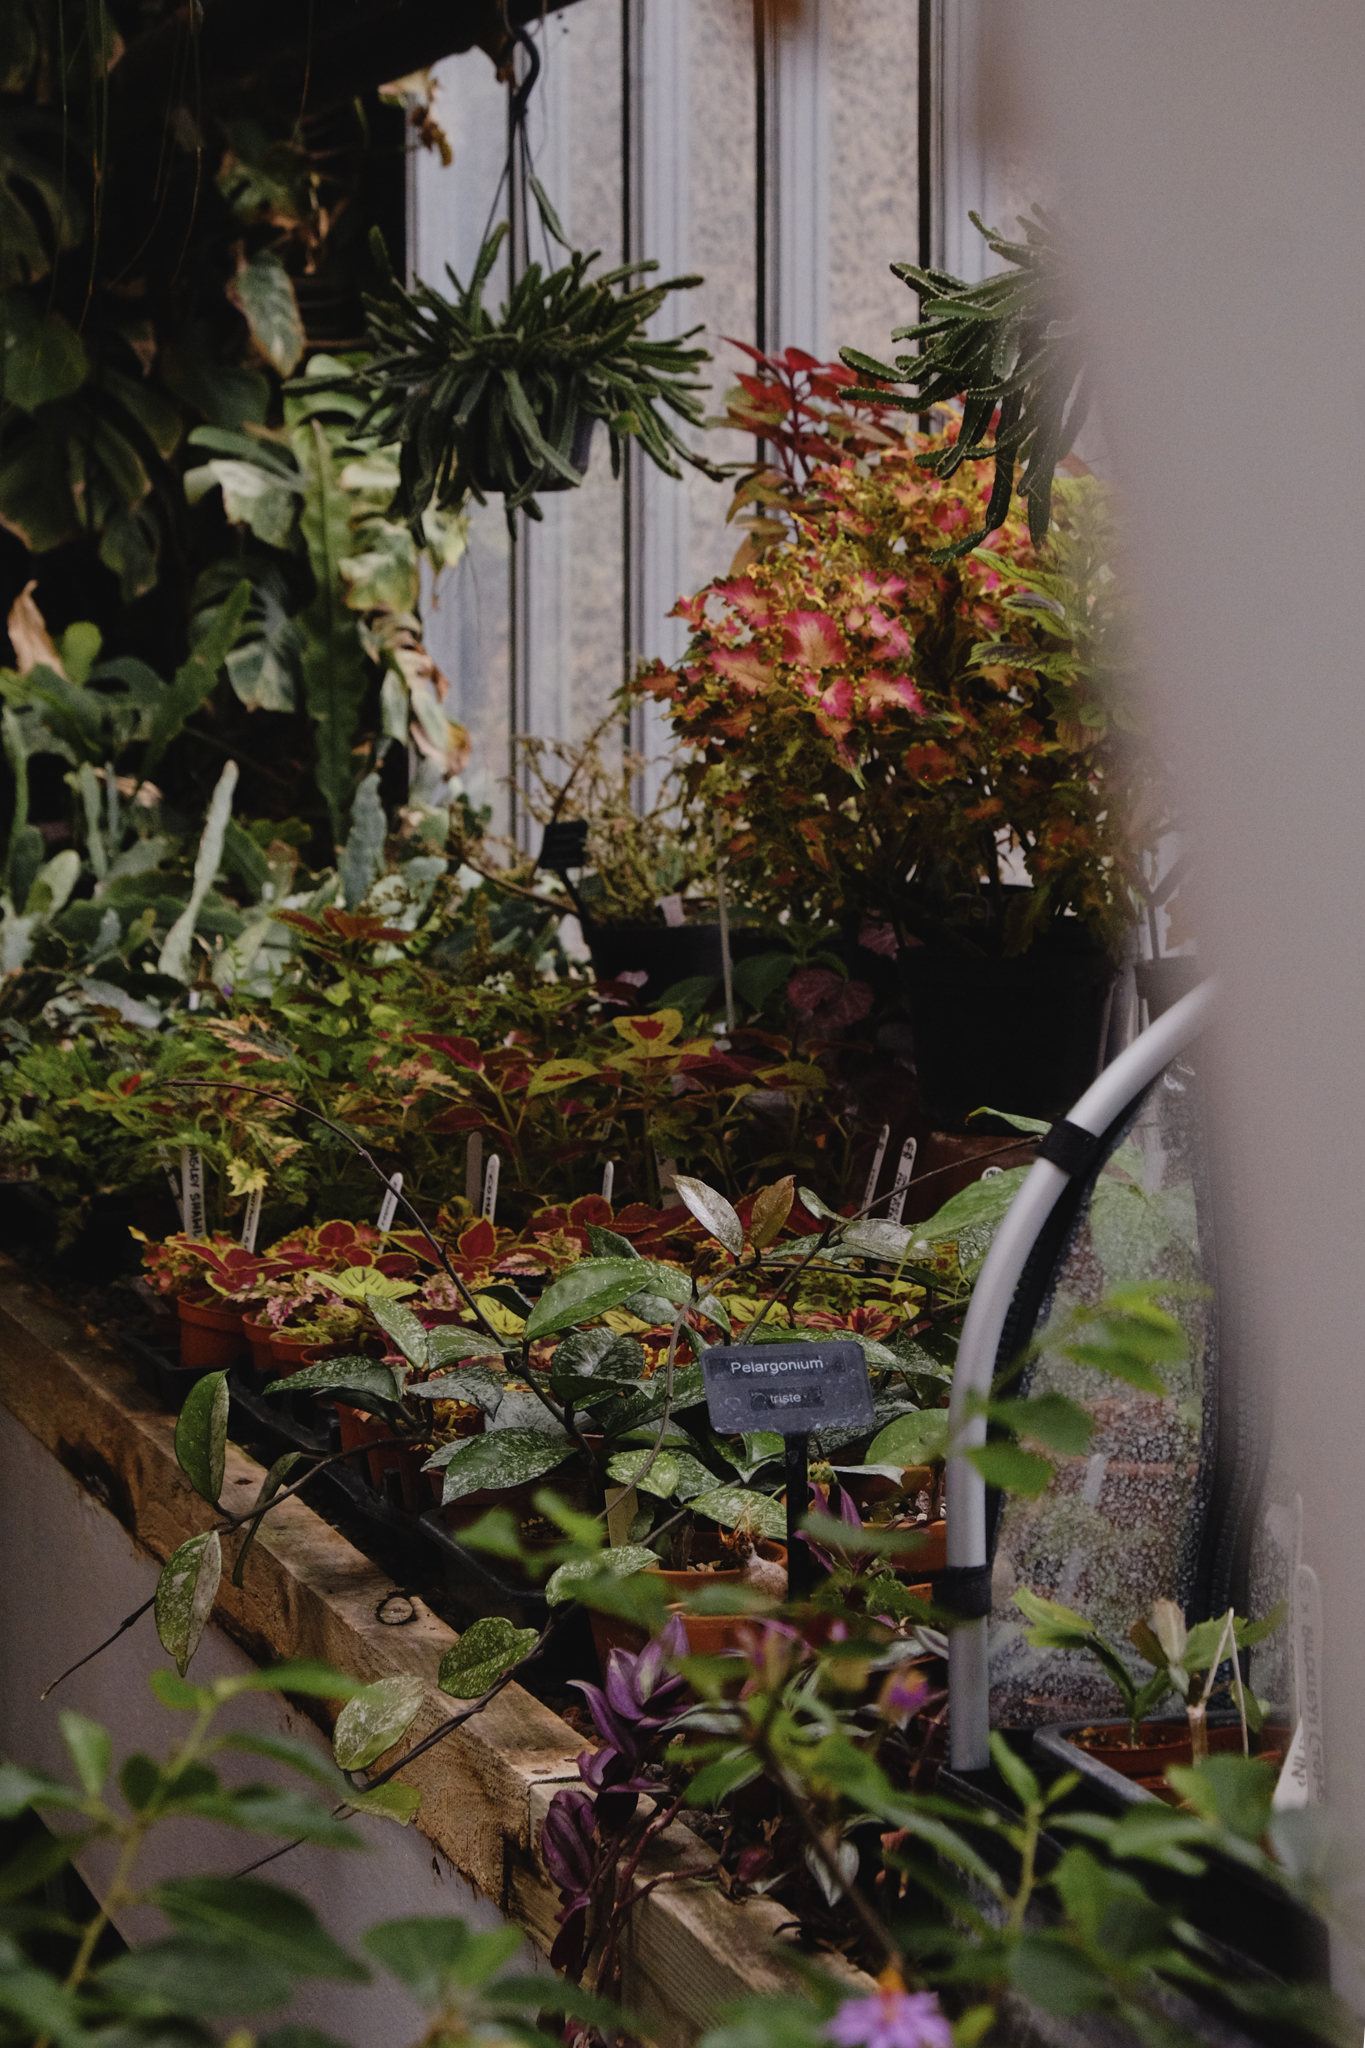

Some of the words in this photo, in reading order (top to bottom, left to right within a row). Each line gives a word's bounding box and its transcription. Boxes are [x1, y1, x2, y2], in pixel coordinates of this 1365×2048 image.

[190, 1193, 204, 1238] SHAWL
[730, 1358, 824, 1376] Pelargonium
[769, 1392, 802, 1405] triste
